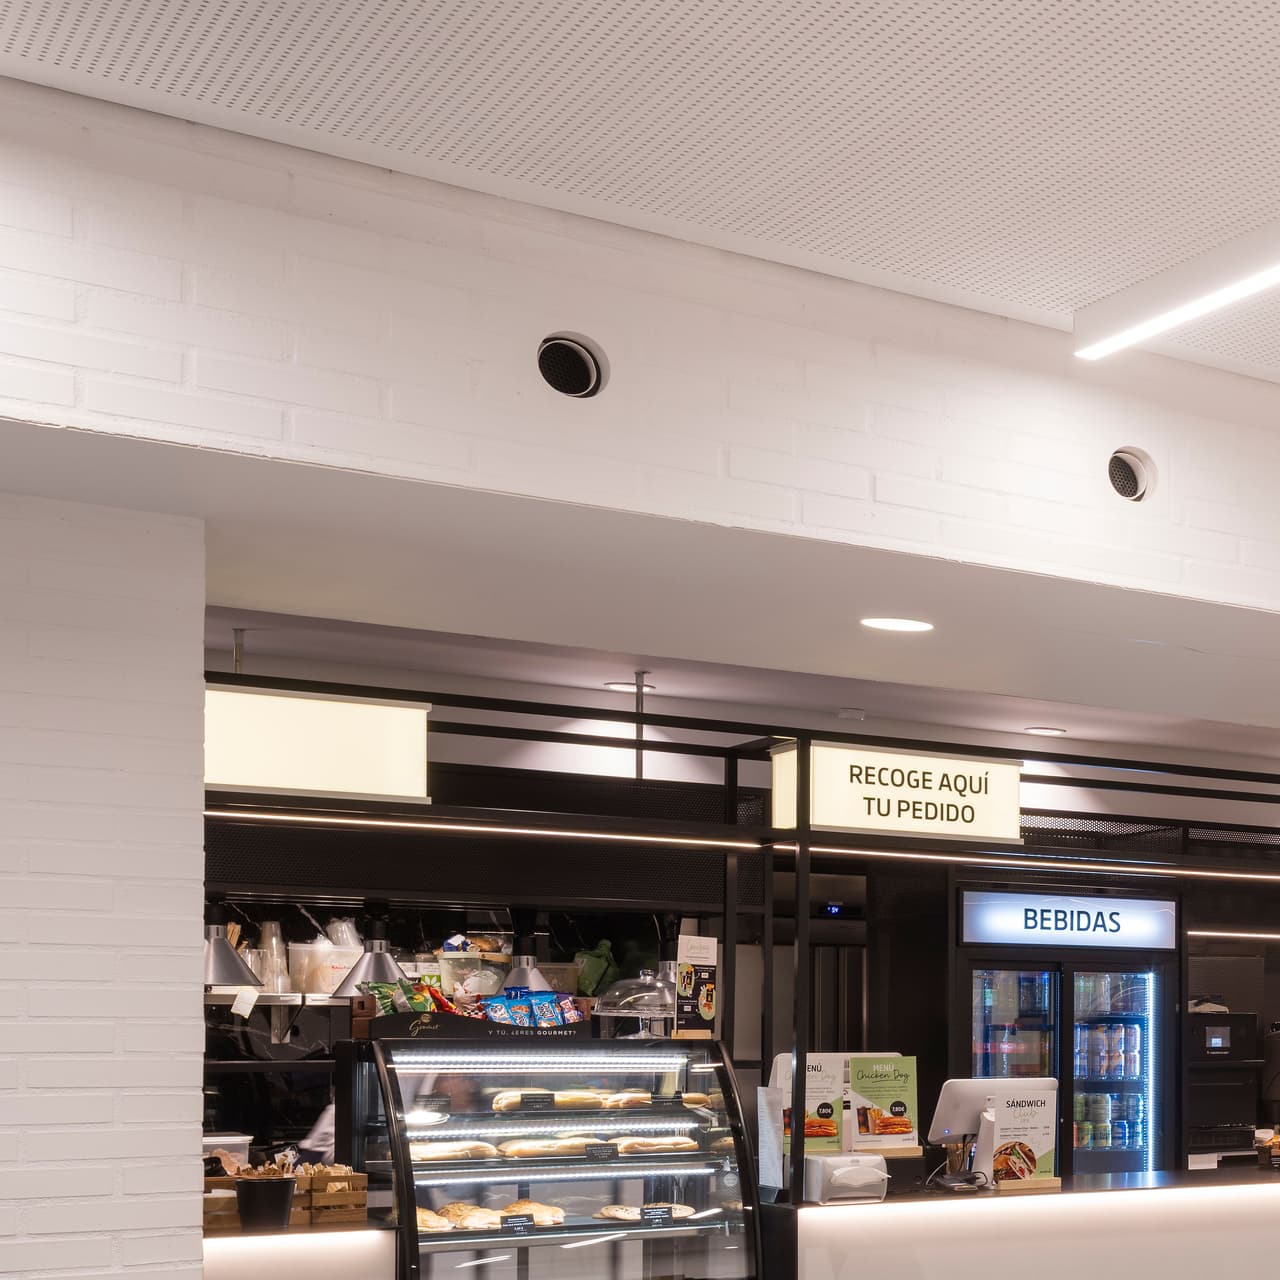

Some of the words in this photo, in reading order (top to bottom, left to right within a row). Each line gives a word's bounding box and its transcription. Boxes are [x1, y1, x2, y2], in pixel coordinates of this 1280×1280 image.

[849, 764, 933, 790] RECOGE
[938, 771, 989, 797] AQUÍ
[863, 796, 891, 817] TU
[897, 799, 975, 823] PEDIDO
[1023, 907, 1121, 933] BEBIDAS
[806, 1062, 822, 1072] ENÚ
[856, 1069, 890, 1080] Chicken
[893, 1069, 911, 1084] Dog
[1006, 1098, 1046, 1108] SÁNDWICH
